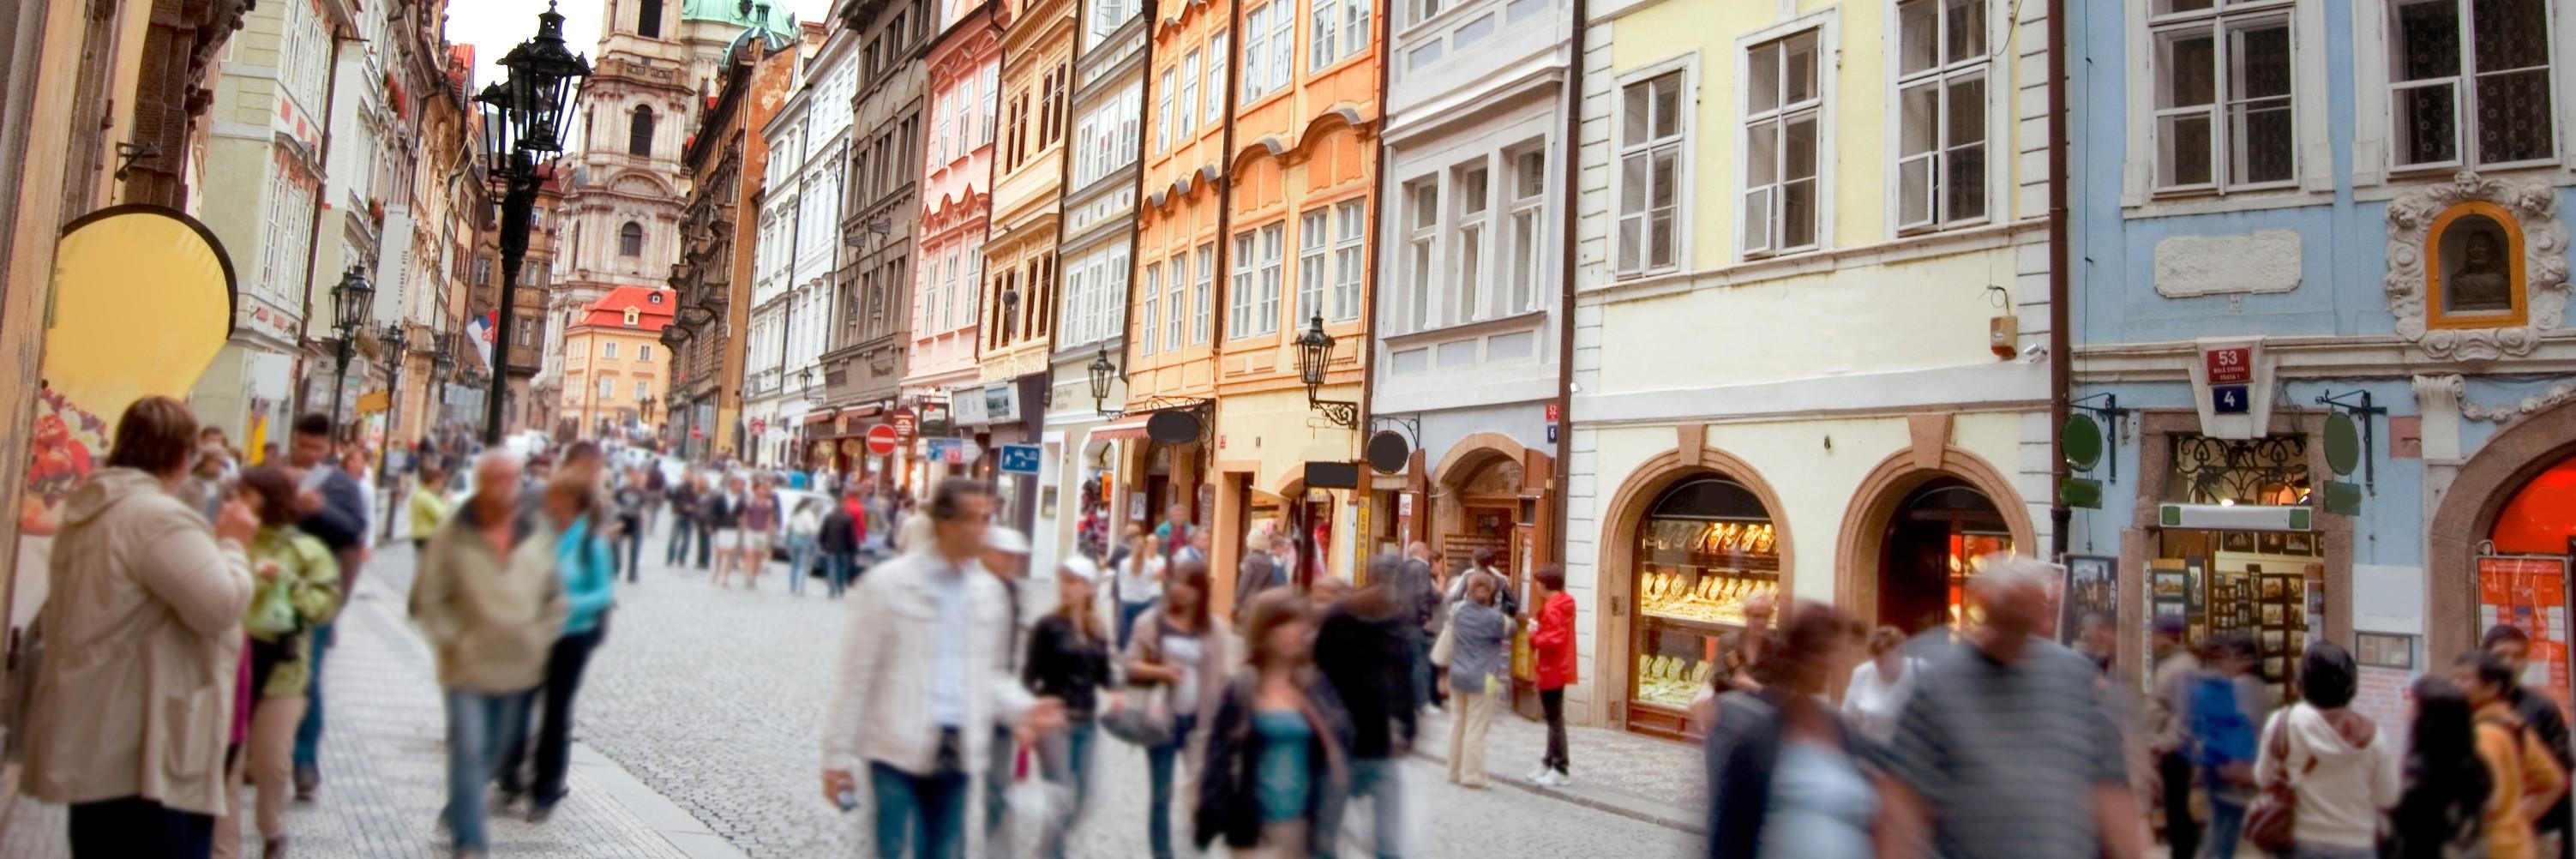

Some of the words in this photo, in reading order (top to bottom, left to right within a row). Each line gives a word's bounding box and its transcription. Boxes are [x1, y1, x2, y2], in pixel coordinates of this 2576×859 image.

[2219, 350, 2237, 365] 53
[2224, 391, 2236, 407] 4
[1550, 428, 1555, 439] 6
